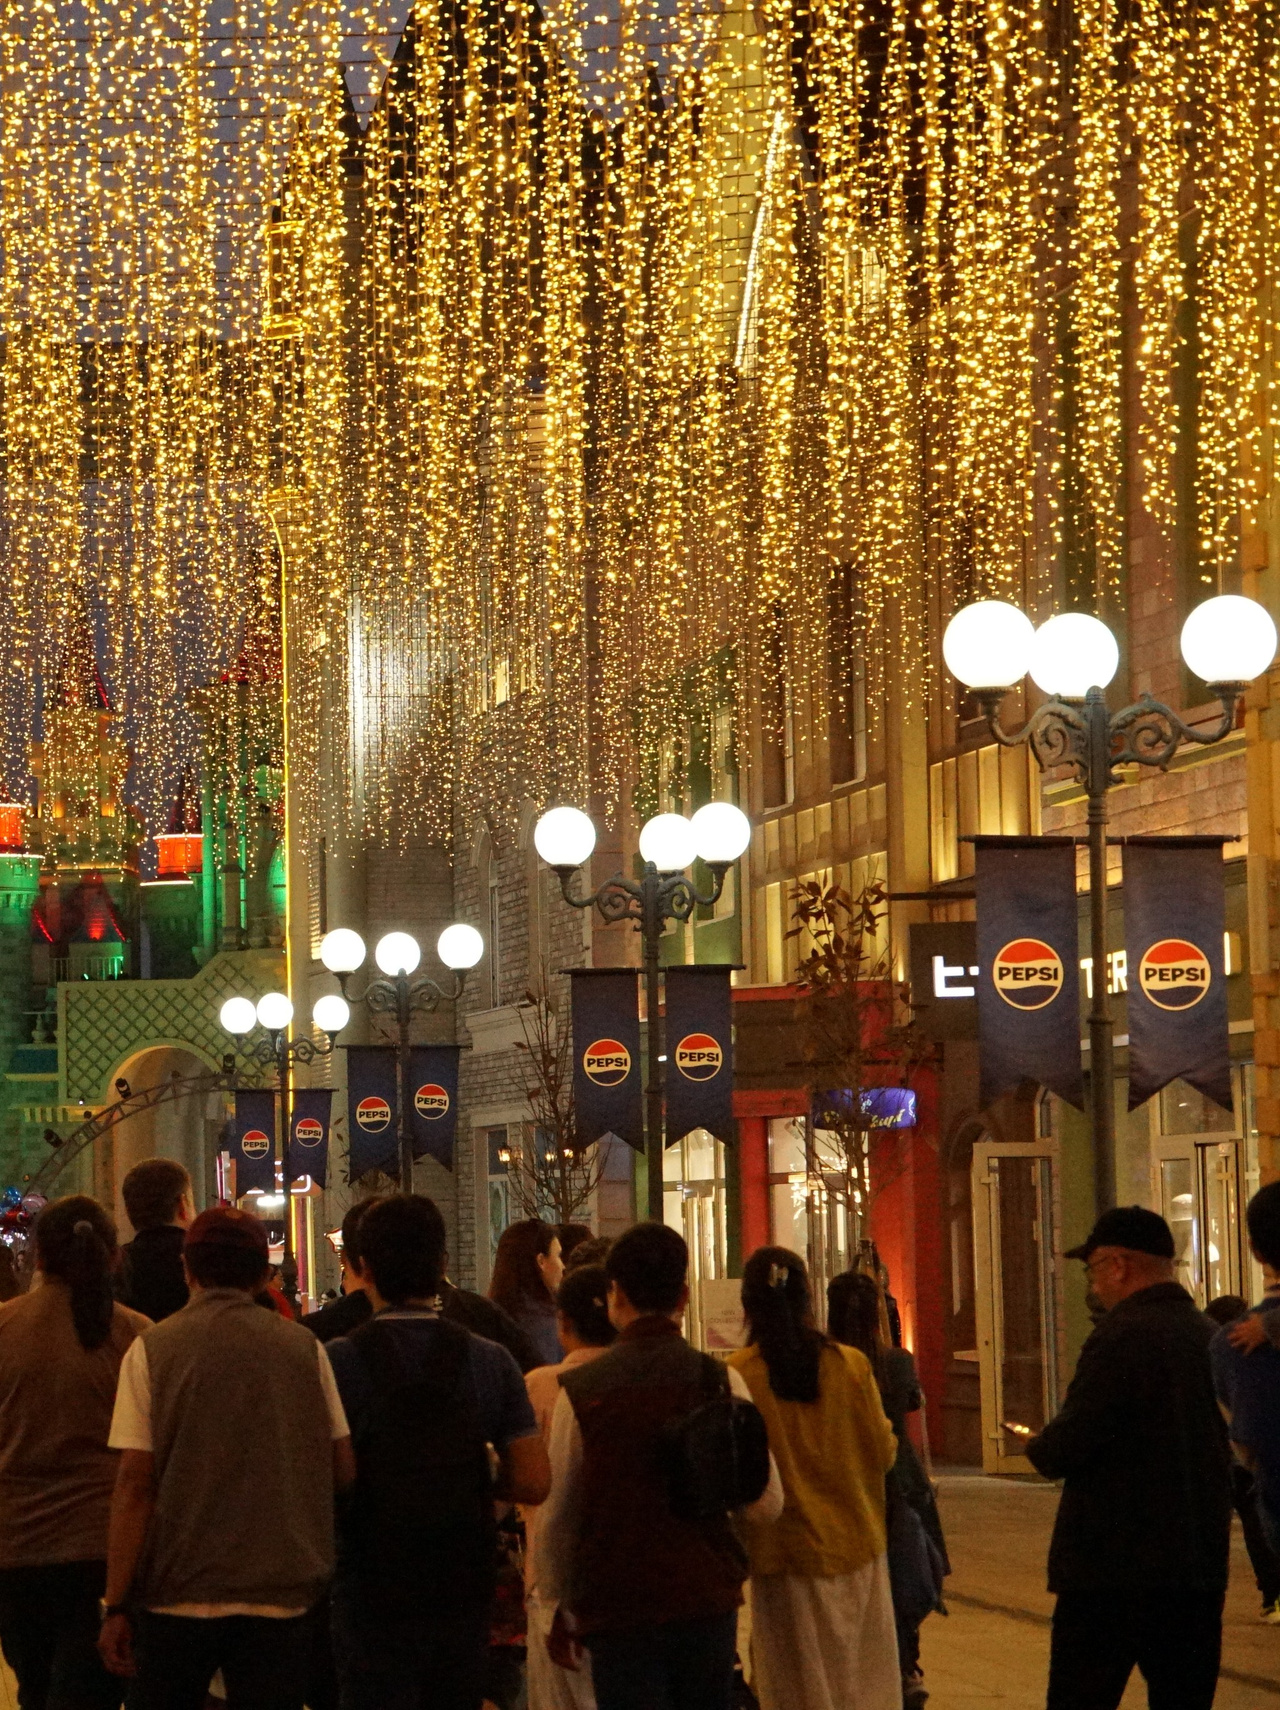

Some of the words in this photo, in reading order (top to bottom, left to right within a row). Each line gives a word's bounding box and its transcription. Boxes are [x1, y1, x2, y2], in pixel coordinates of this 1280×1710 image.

[998, 966, 1059, 981] PEPSI
[1145, 967, 1206, 981] PEPSI
[679, 1051, 719, 1062] PEPSI
[587, 1057, 628, 1067] PEPSI
[417, 1096, 447, 1107] PEPSI
[358, 1110, 389, 1119] PEPSI
[297, 1128, 321, 1137] PEPSI
[243, 1141, 268, 1149] PEPSI
